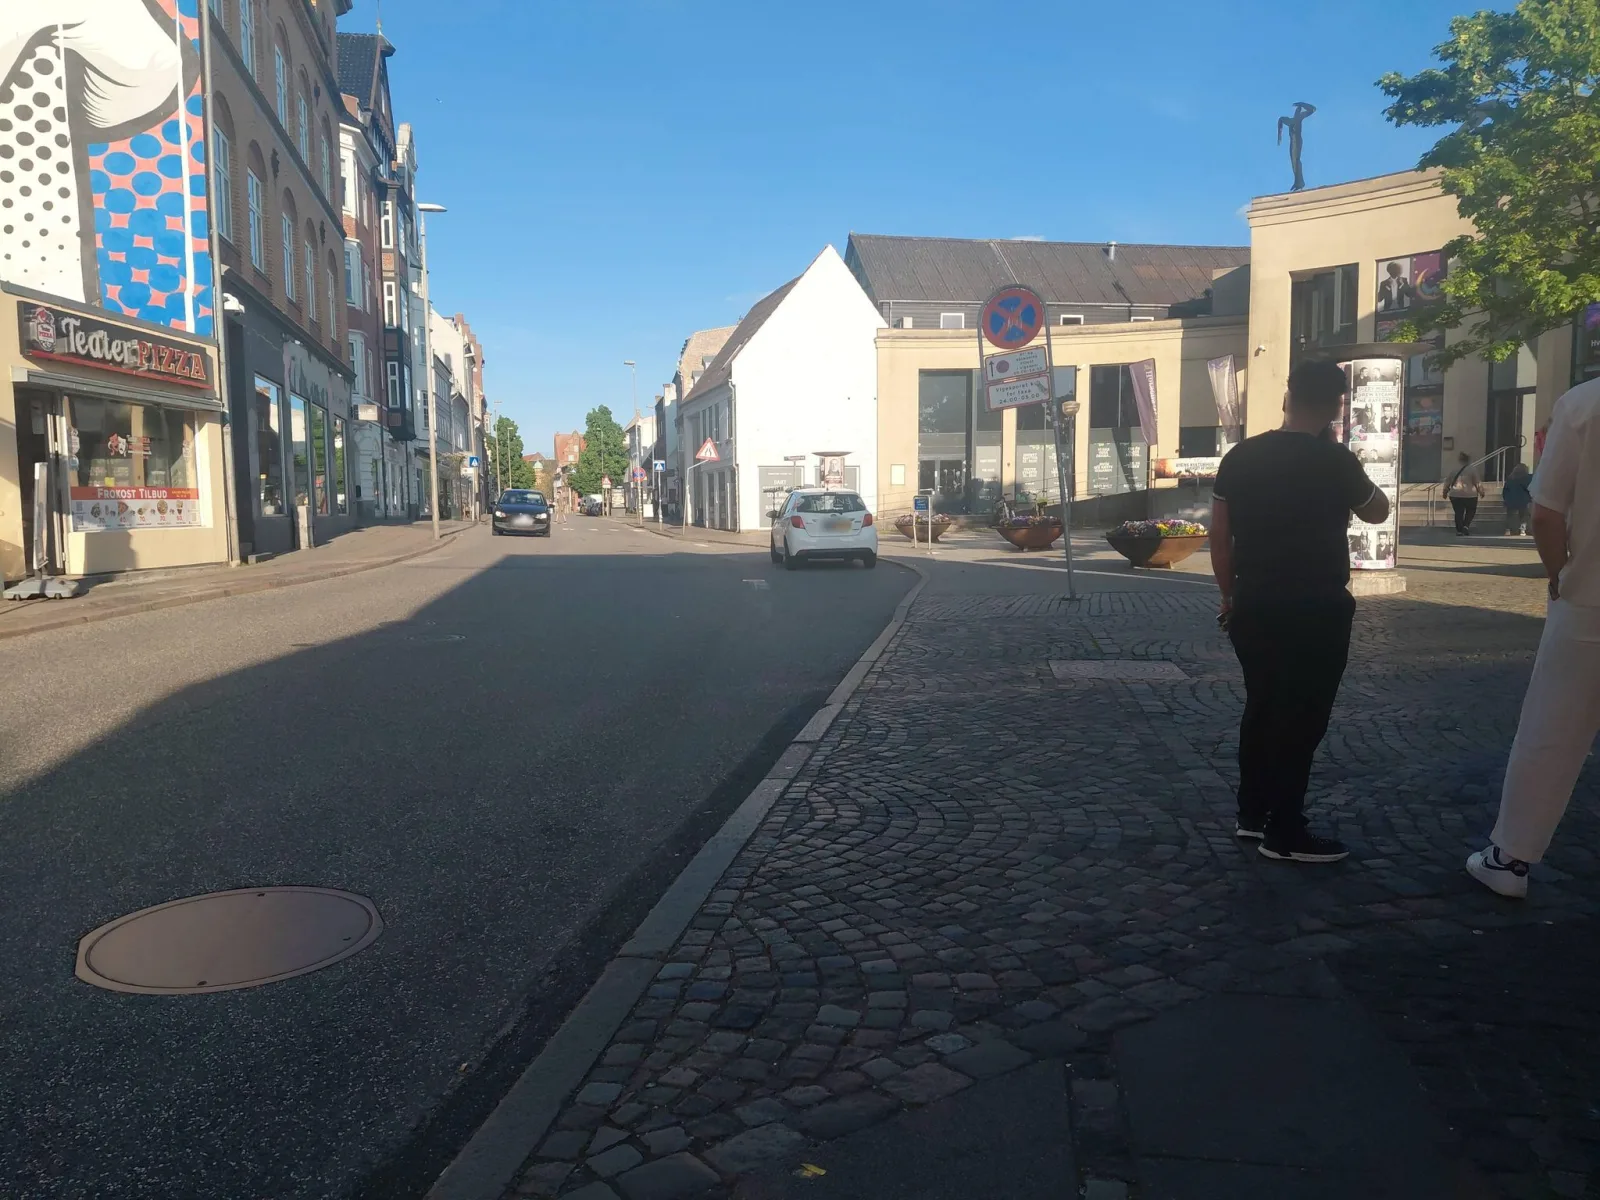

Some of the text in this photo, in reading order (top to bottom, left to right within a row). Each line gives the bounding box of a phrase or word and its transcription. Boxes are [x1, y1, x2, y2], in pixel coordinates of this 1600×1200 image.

[60, 316, 206, 380] Teater PIZZA
[97, 488, 136, 499] FROKOST
[139, 488, 167, 499] TILBUD
